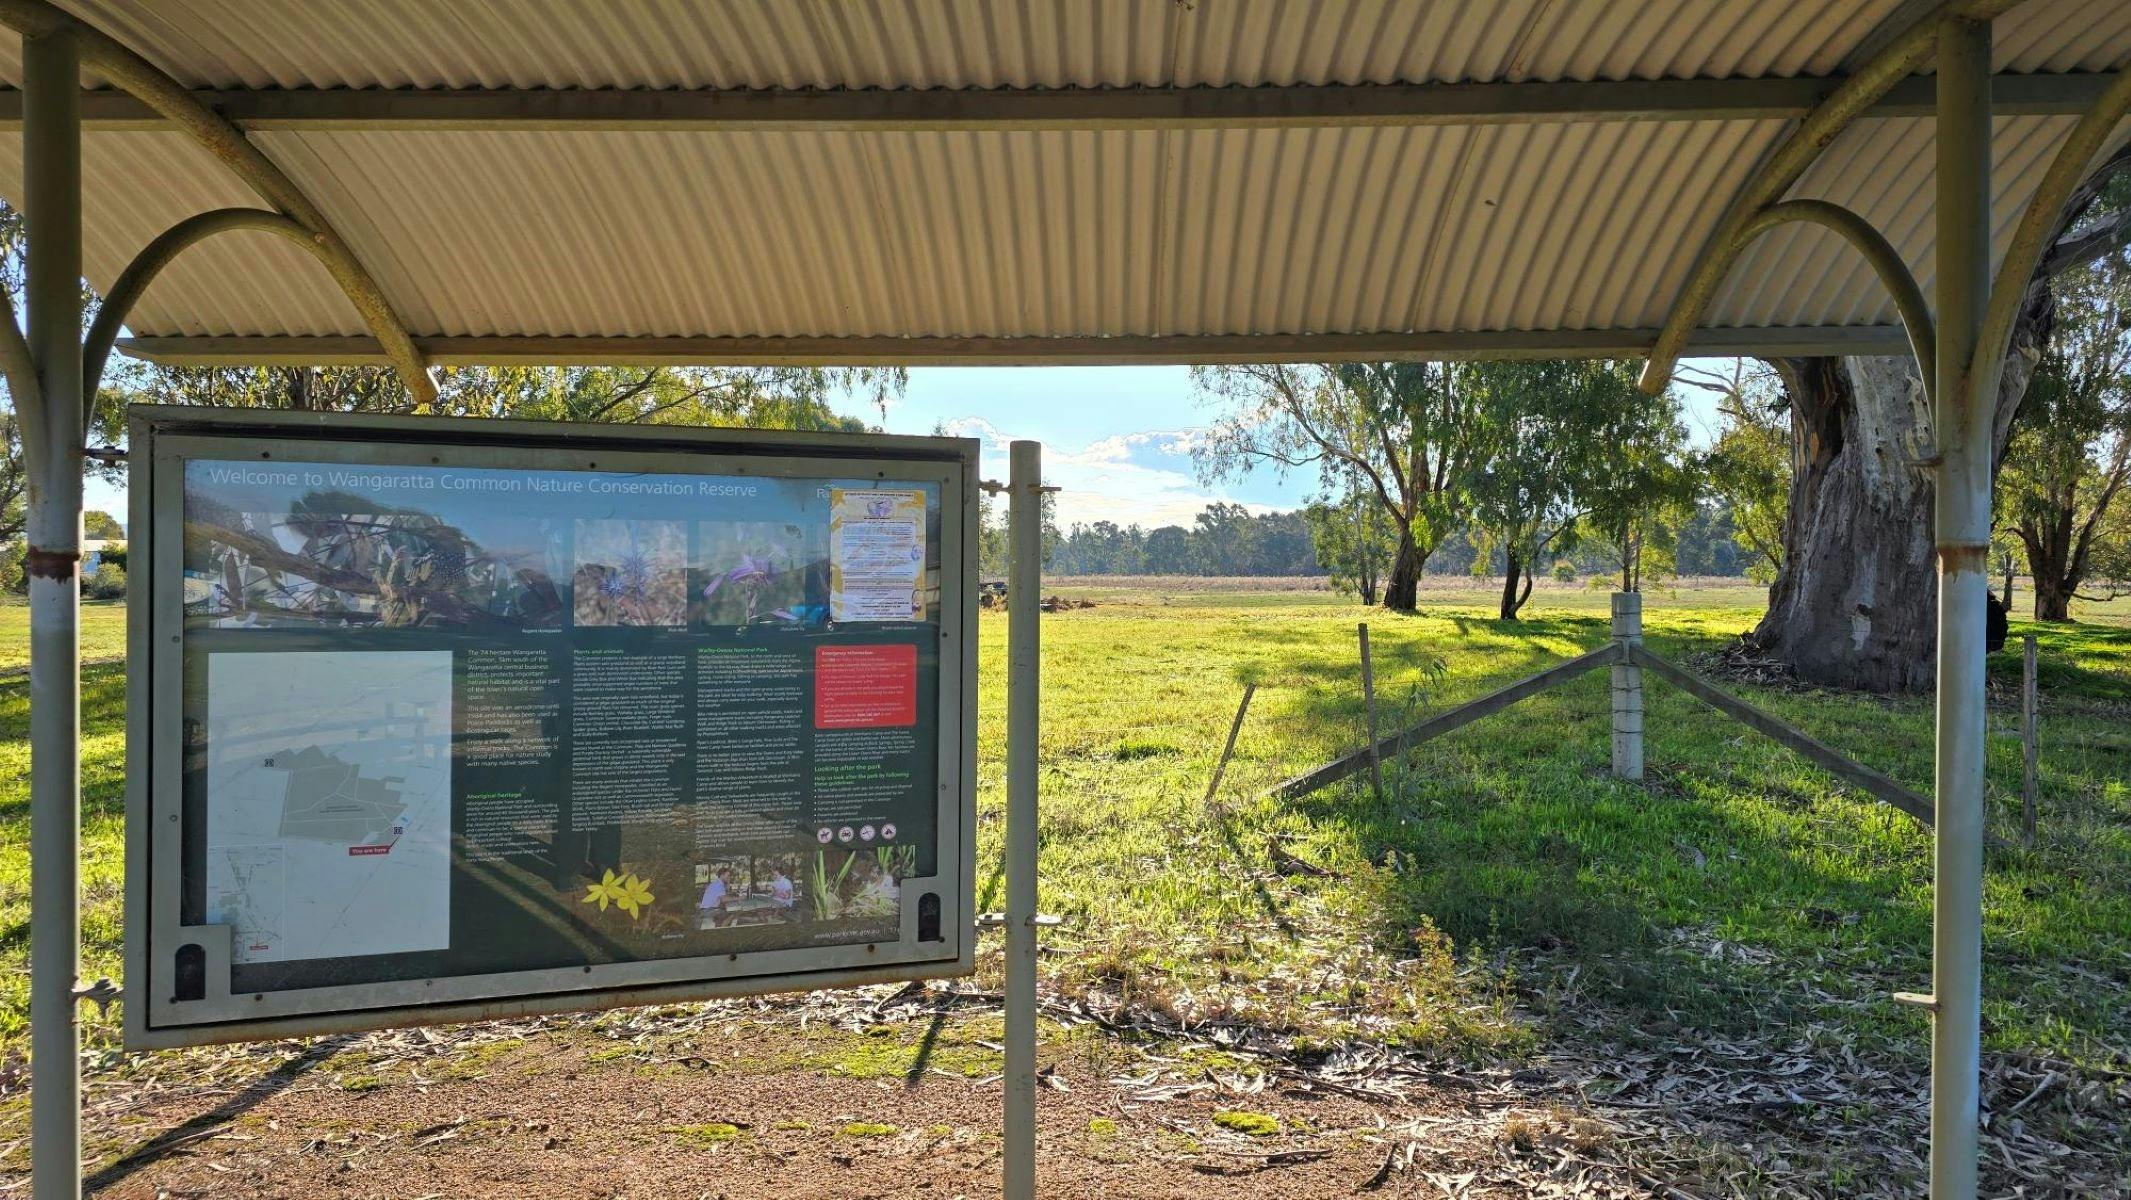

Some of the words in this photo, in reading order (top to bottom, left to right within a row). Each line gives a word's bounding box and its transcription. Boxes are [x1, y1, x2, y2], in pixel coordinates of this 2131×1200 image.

[209, 468, 297, 486] Welcome
[304, 472, 322, 486] to
[328, 471, 434, 491] Wangaratta
[441, 474, 521, 491] Common
[527, 477, 583, 493] Nature
[588, 478, 693, 496] Conservation
[699, 482, 757, 497] Reserve
